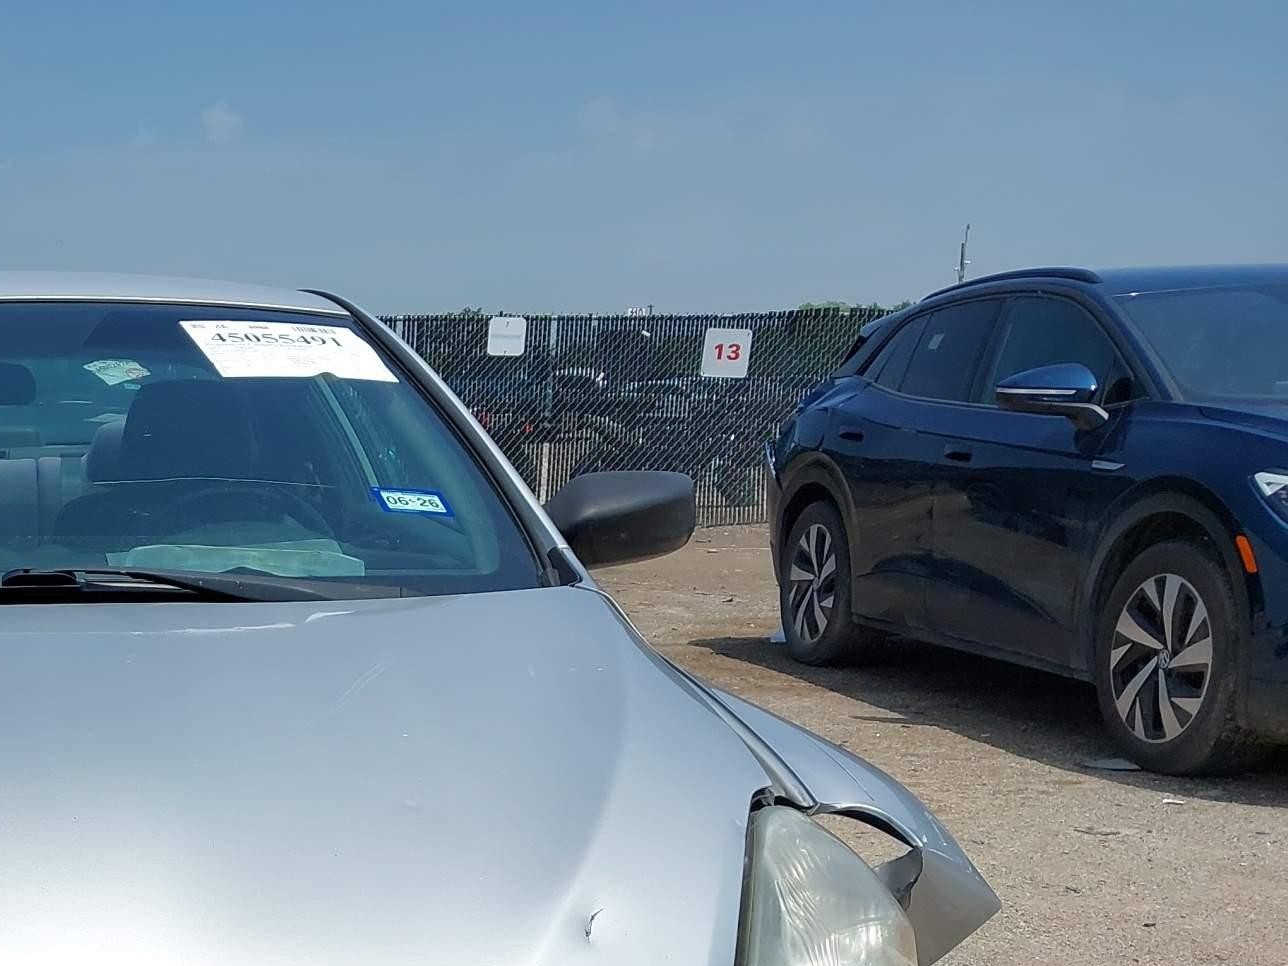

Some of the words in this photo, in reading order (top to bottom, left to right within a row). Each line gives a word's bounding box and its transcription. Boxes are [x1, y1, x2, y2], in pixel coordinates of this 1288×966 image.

[211, 332, 343, 347] 45055491
[714, 343, 741, 360] 13
[386, 496, 439, 508] 06-26
